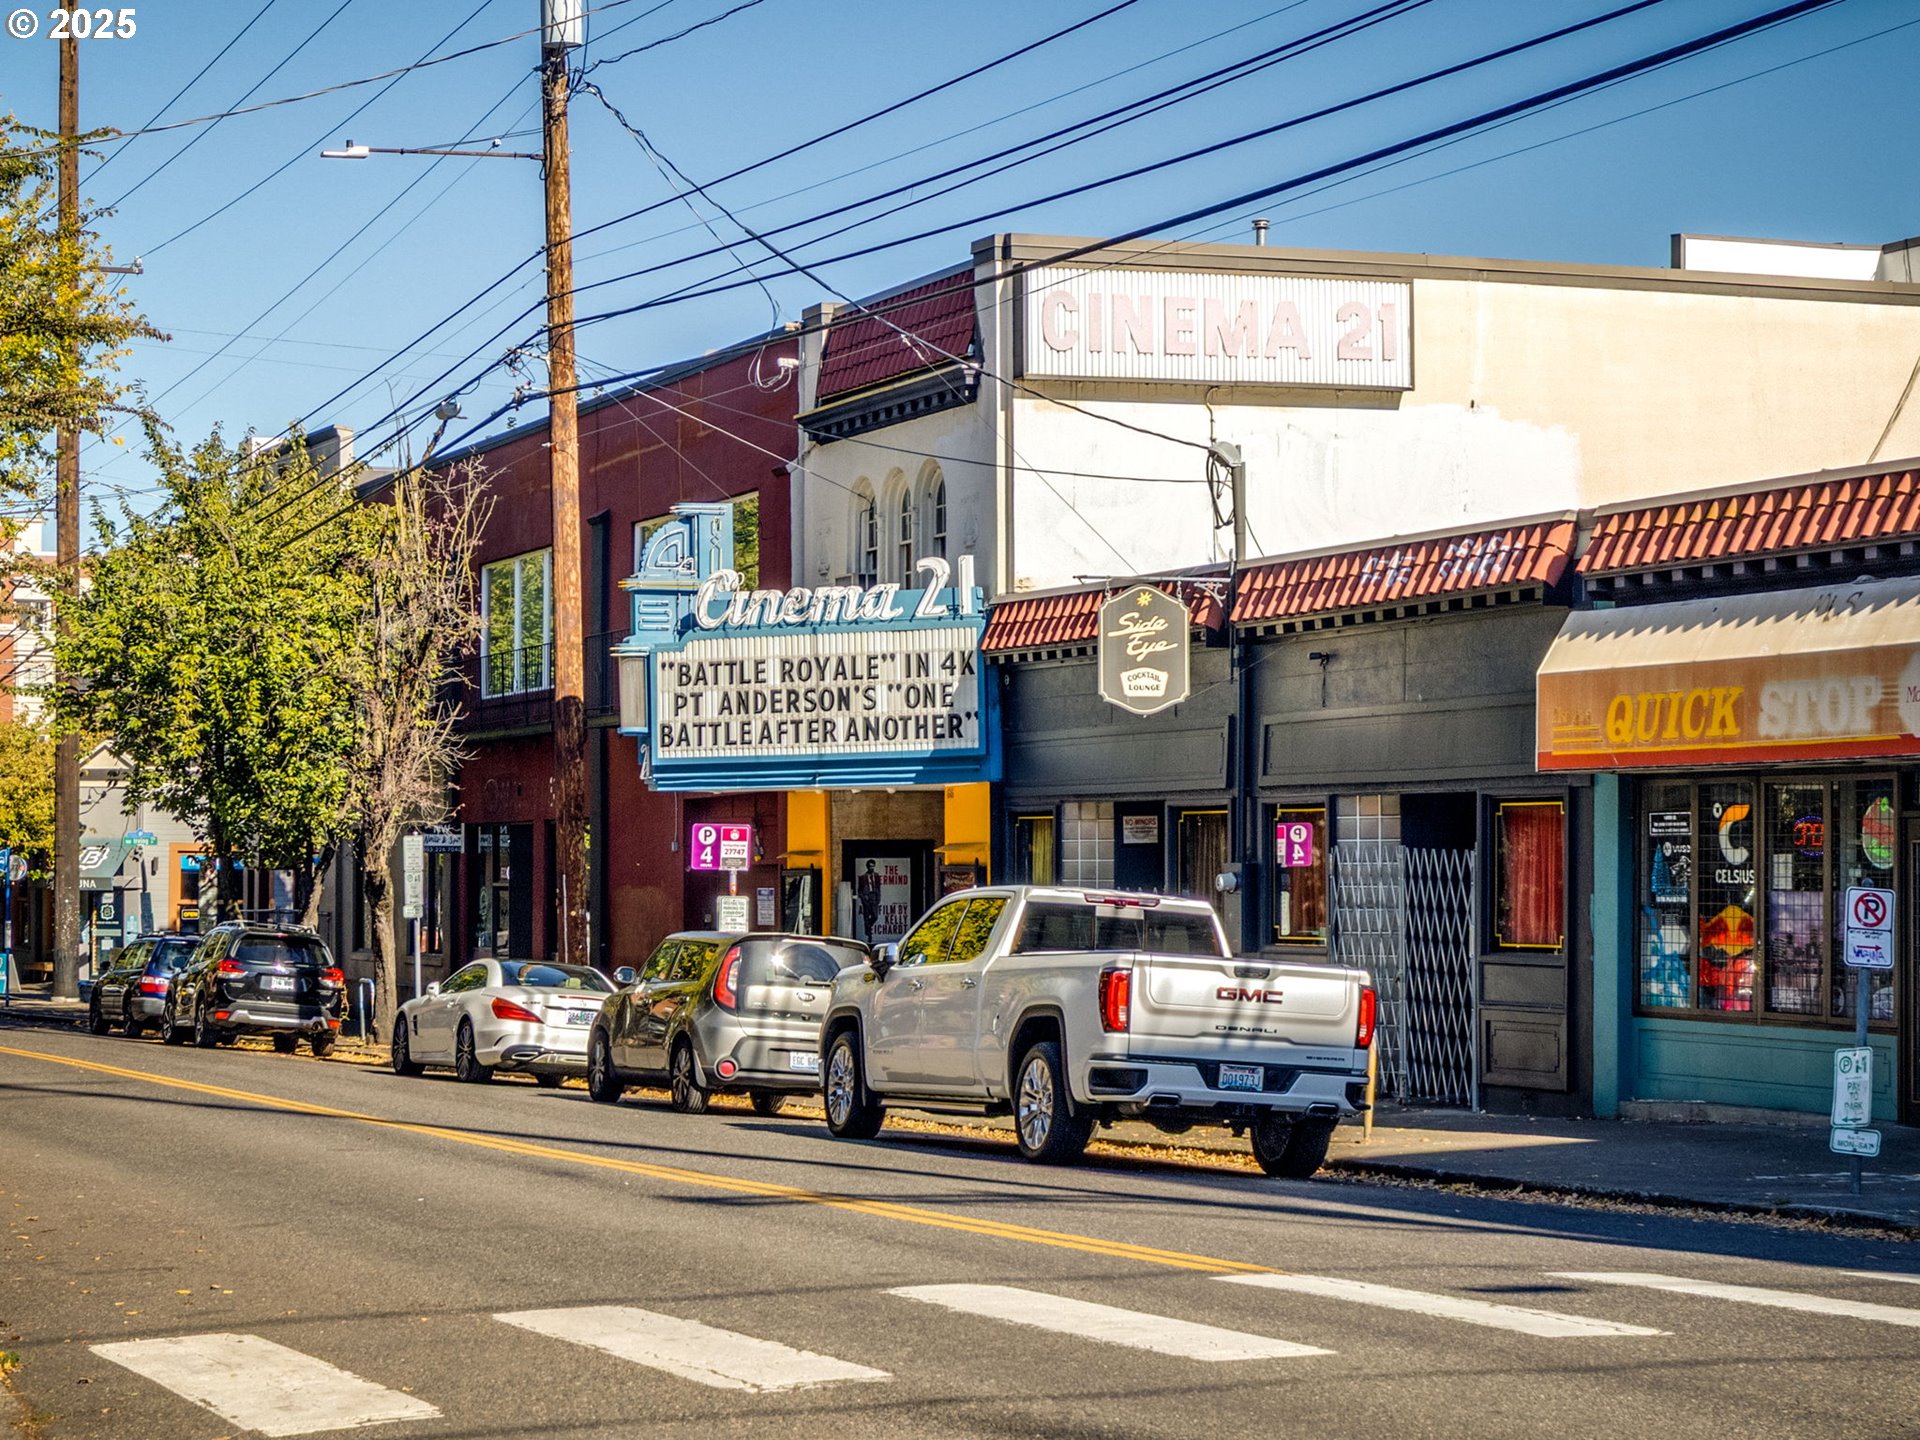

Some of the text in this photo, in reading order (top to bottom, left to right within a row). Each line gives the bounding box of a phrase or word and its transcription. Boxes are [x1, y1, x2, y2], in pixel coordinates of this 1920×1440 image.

[1042, 290, 1397, 361] CINEMA 21
[695, 555, 975, 630] Cinema 21
[1108, 611, 1168, 637] Side
[1126, 631, 1178, 662] Eye
[660, 649, 976, 688] "BATTLE ROYALE" IN 4K
[1127, 671, 1161, 682] COCKTAIL
[674, 681, 954, 717] PT ANDERSON'S "ONE
[1606, 685, 1745, 745] QUICK
[1758, 675, 1882, 738] STOP
[660, 711, 980, 749] BATTLE AFTER ANOTHER"
[700, 846, 713, 863] 4
[884, 865, 898, 874] THE
[1715, 869, 1755, 884] CELSIUS
[880, 875, 909, 886] ERMIND
[879, 904, 897, 915] FILM
[898, 904, 908, 915] BY
[885, 914, 908, 925] KELLY
[871, 924, 908, 935] EICHARDT
[1216, 986, 1283, 1005] GMC
[1215, 1025, 1277, 1034] DENALI
